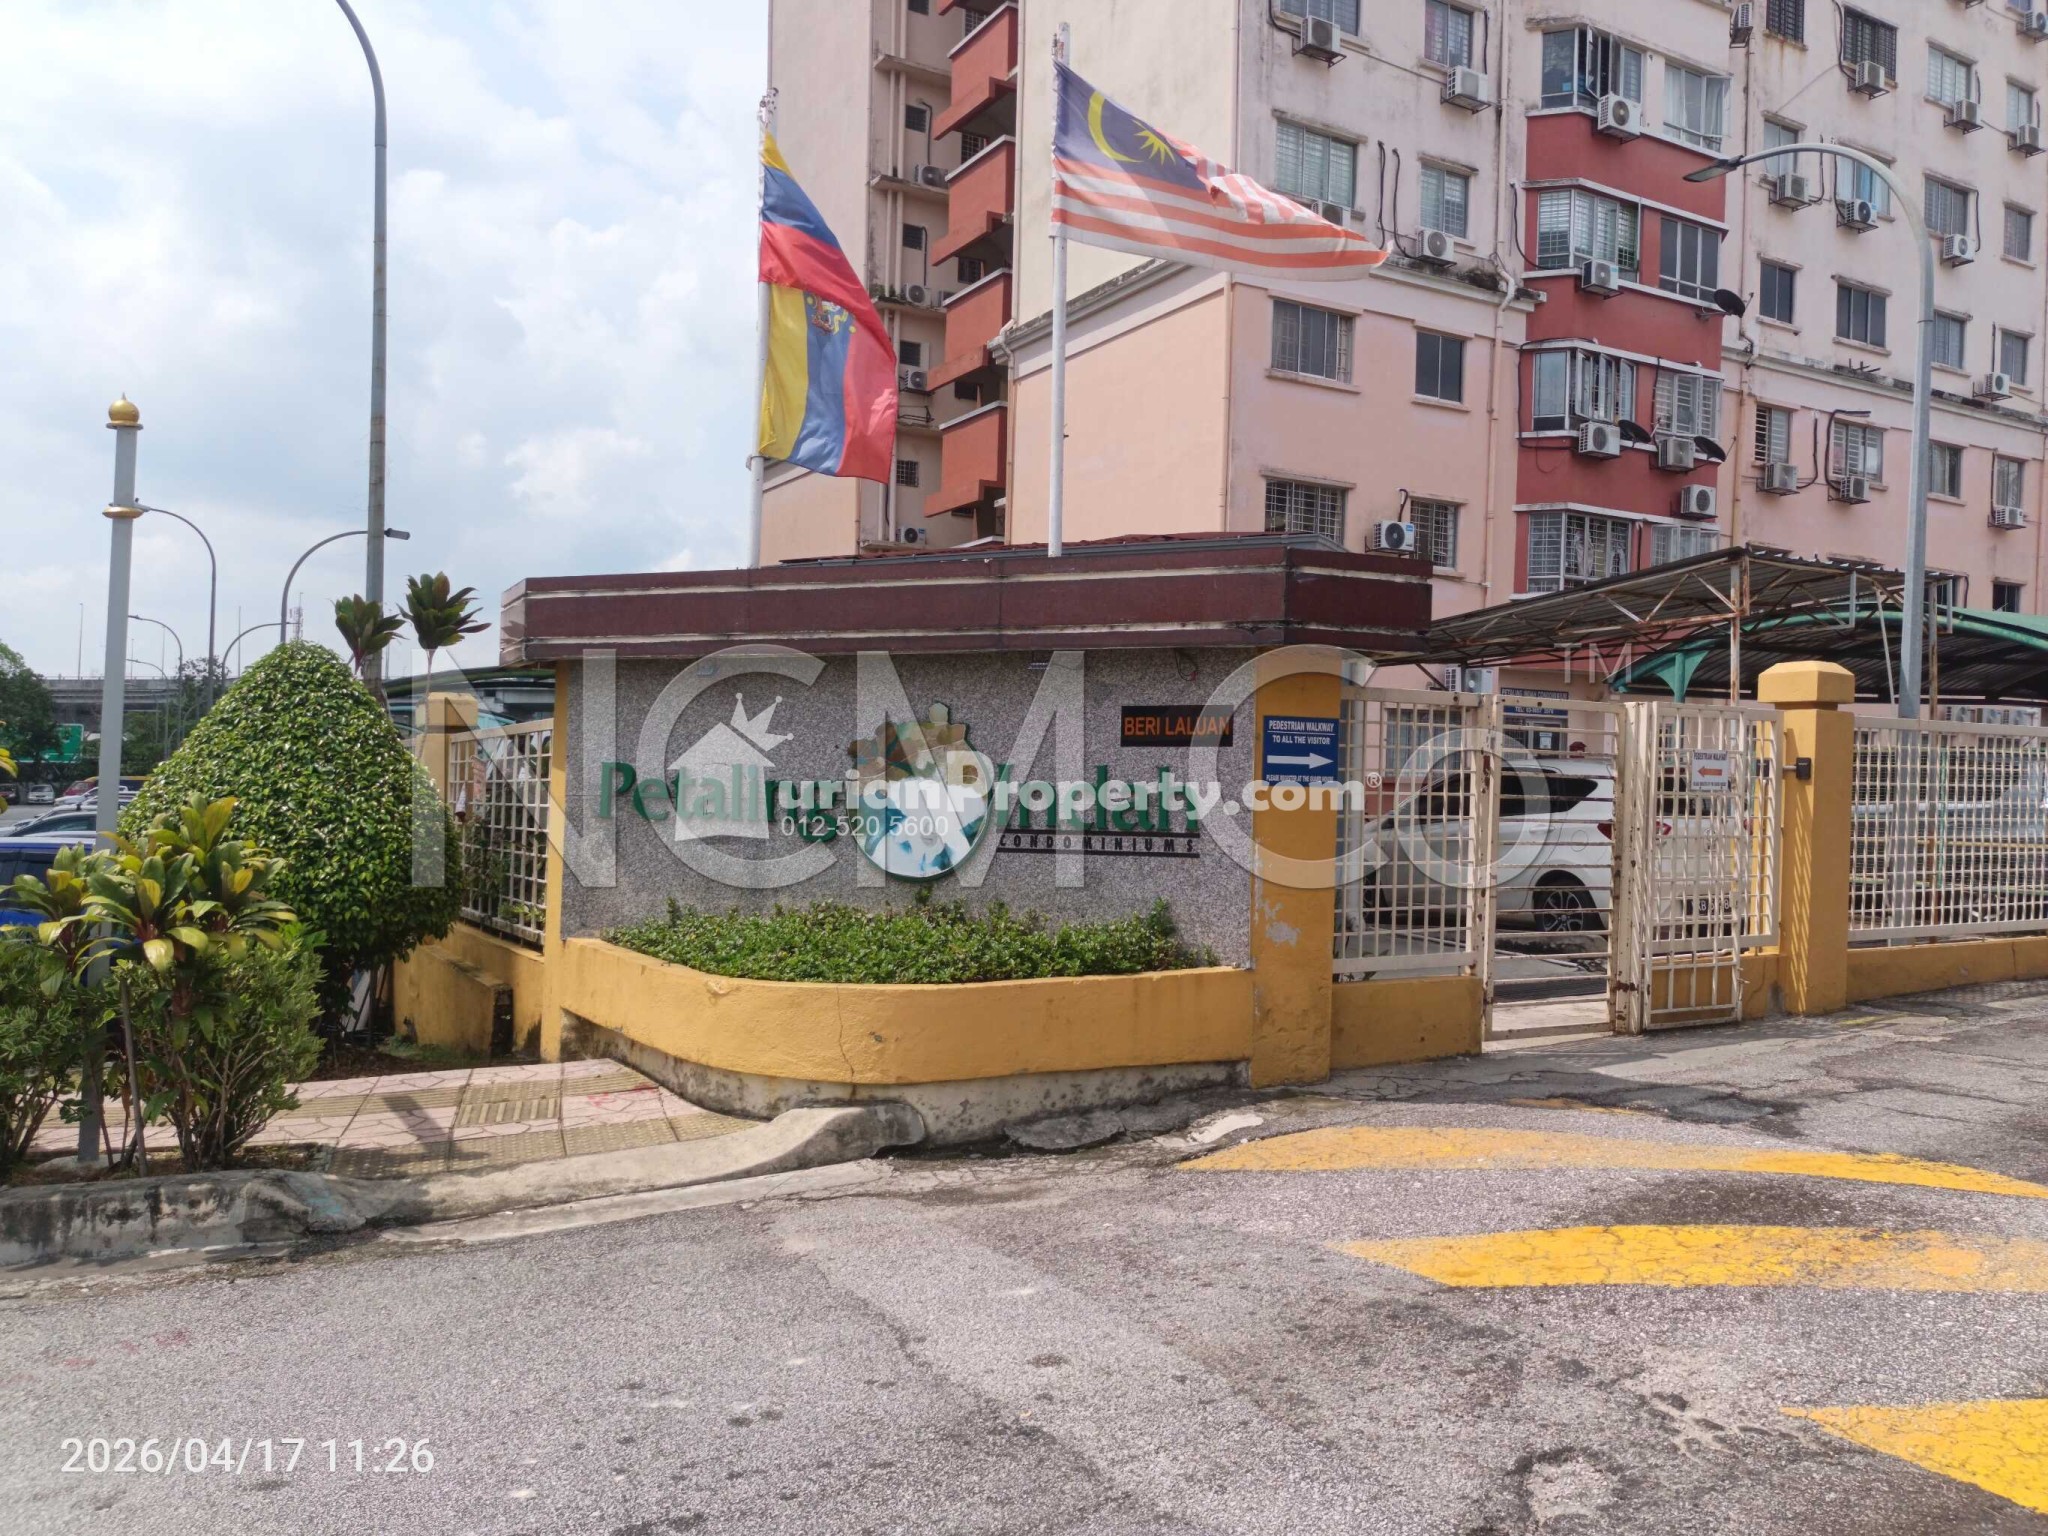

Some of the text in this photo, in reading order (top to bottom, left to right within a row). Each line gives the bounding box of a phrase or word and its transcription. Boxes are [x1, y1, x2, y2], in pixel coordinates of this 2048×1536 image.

[1124, 716, 1230, 736] BERI LALUAN
[1269, 720, 1334, 732] PEDESTRIAN WALKWAY
[1273, 735, 1331, 745] TO ALL THE VISITOR
[600, 761, 837, 843] Petaling
[1000, 833, 1194, 852] CONDOMINIUMS
